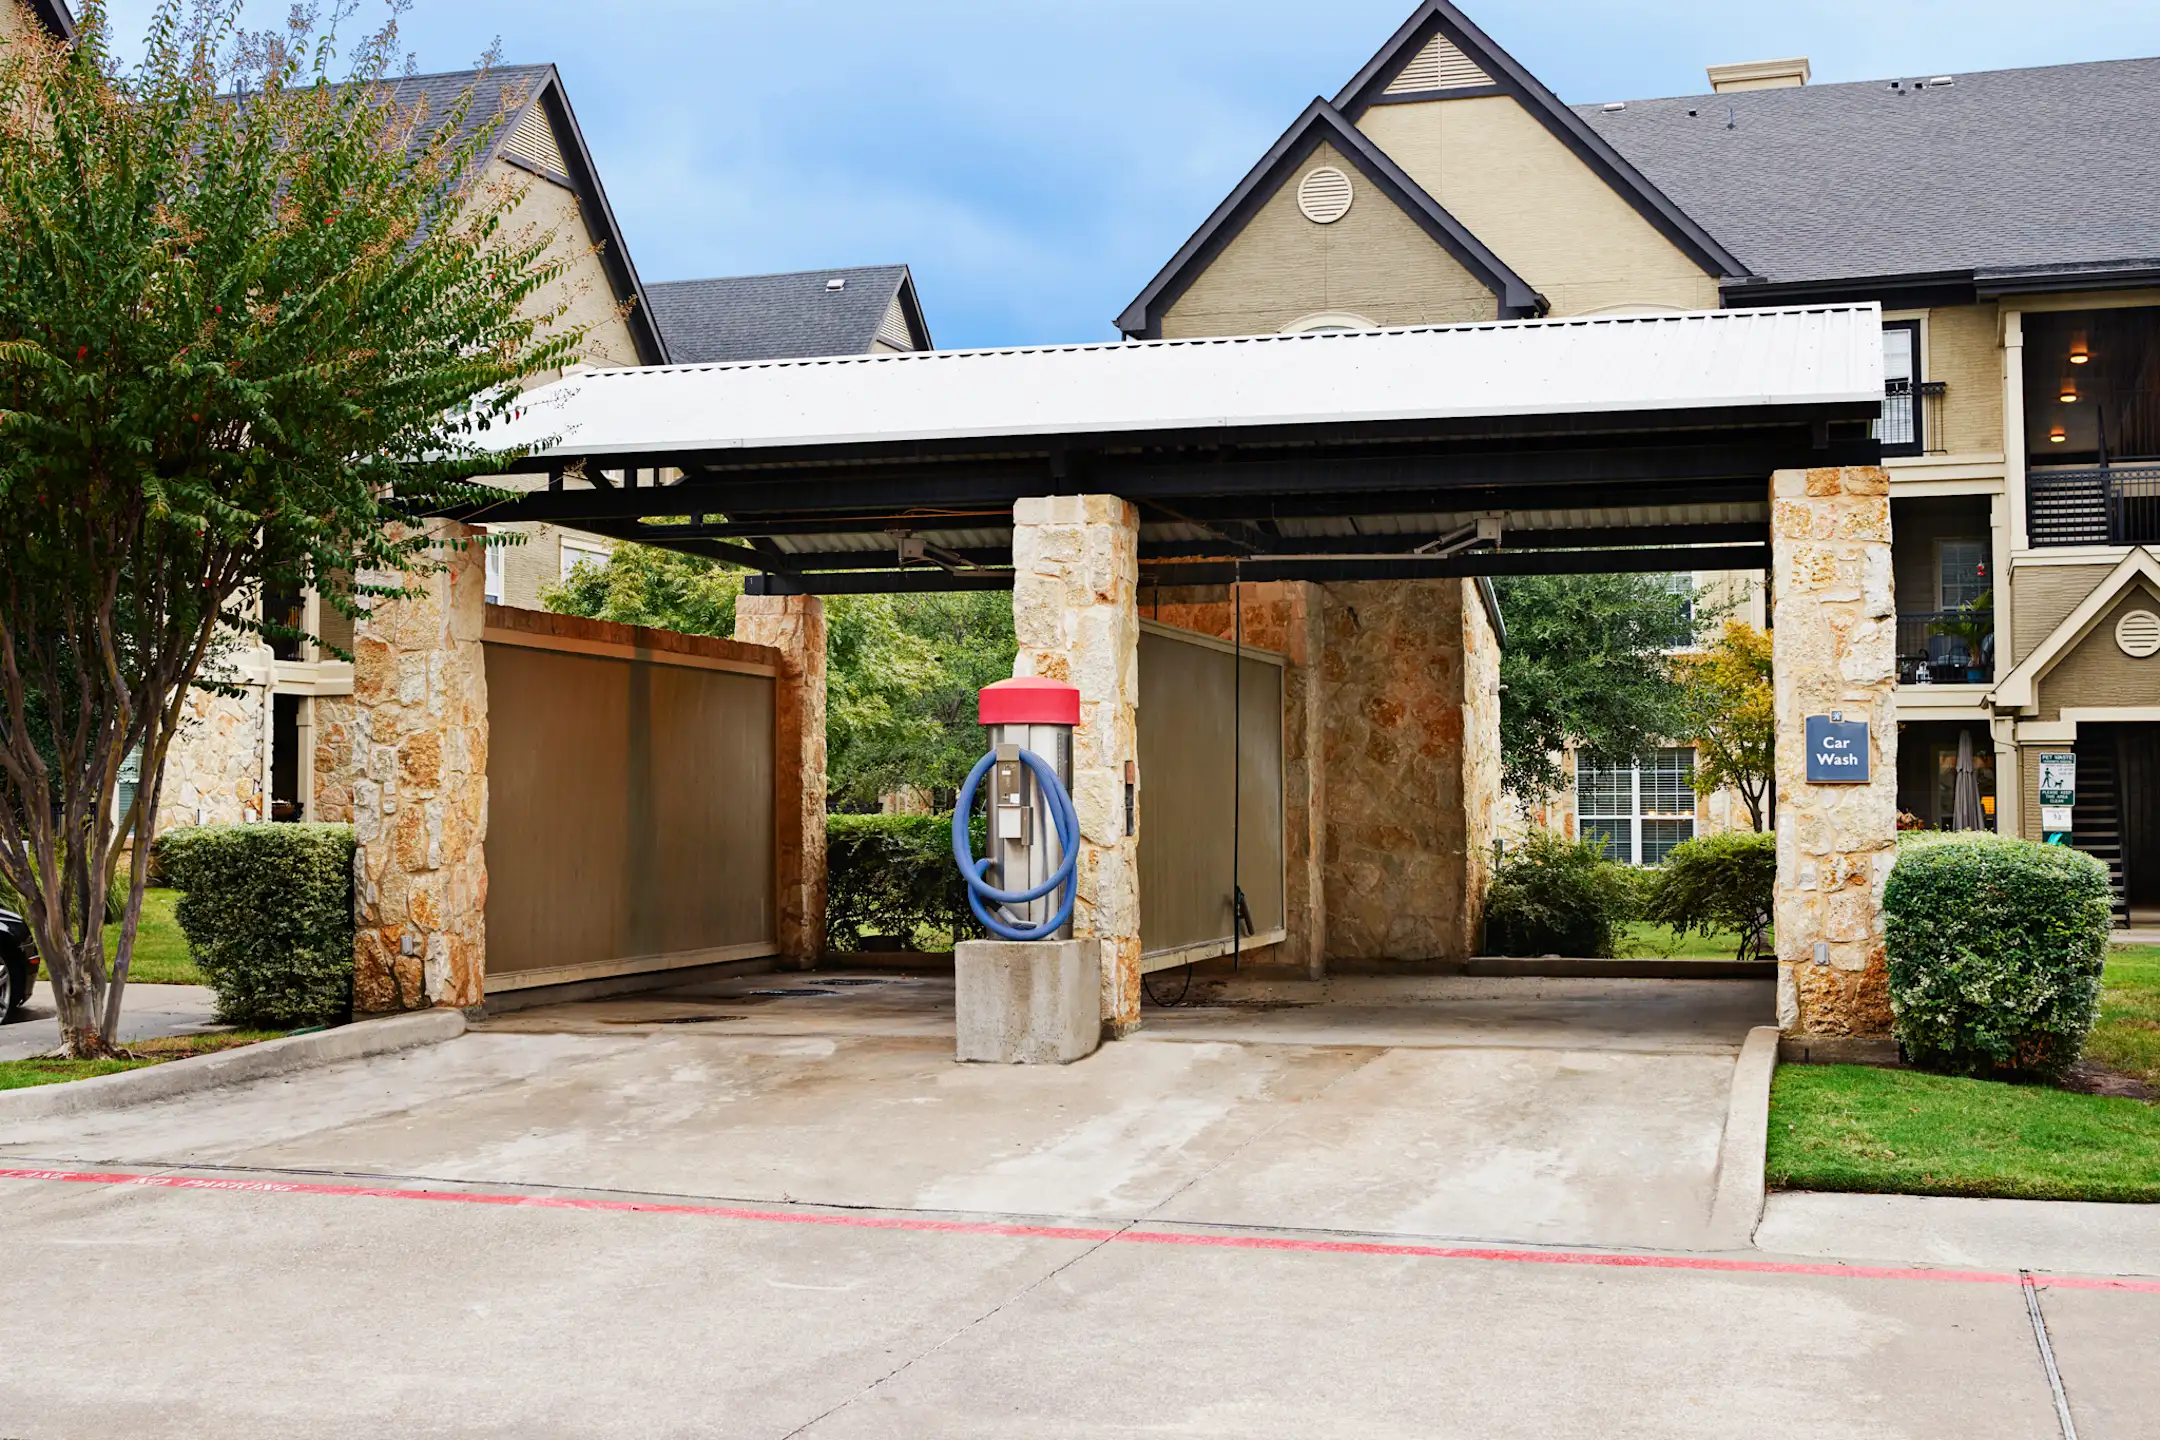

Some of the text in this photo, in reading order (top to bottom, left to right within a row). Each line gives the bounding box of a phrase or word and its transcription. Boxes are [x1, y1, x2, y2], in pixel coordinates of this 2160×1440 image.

[1823, 736, 1850, 749] Car
[1816, 753, 1859, 766] Wash
[178, 1179, 299, 1192] PARKING
